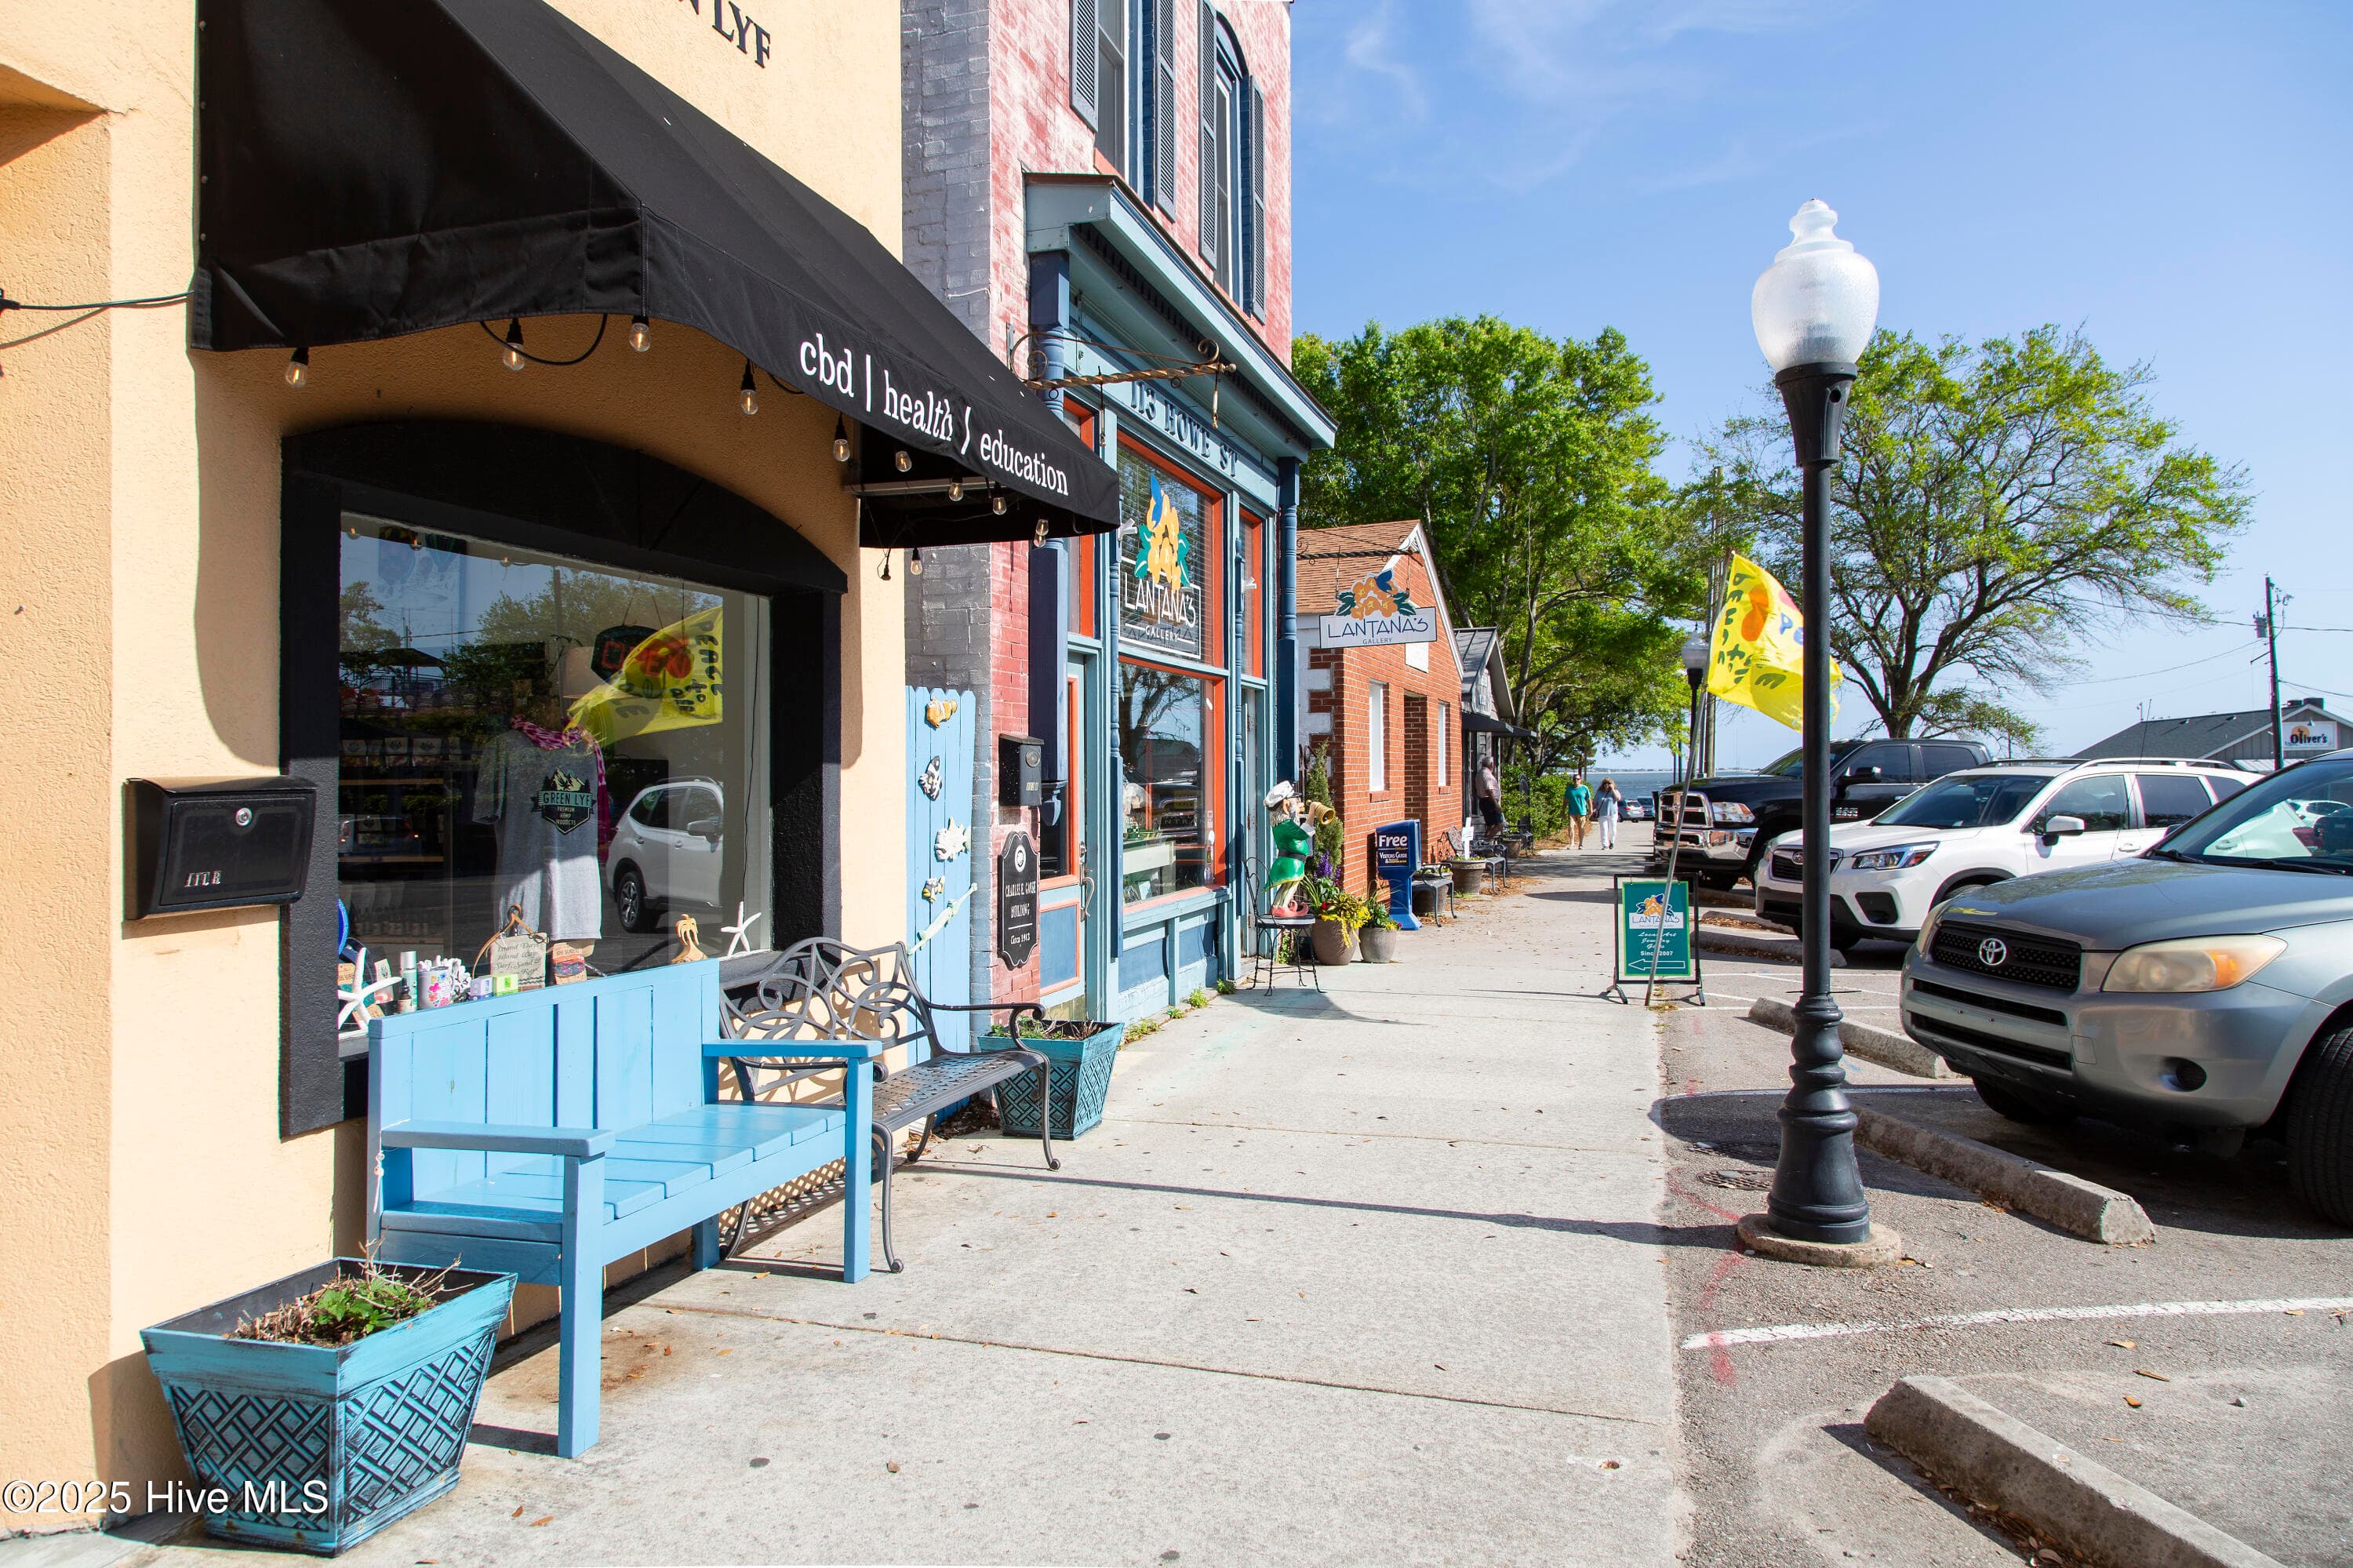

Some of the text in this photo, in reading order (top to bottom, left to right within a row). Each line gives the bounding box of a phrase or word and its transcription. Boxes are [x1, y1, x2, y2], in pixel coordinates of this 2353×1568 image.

[712, 0, 771, 69] LYF
[799, 333, 1069, 497] cbd health education
[1165, 399, 1211, 458] HOWE
[1220, 442, 1238, 477] ST
[1125, 572, 1197, 628] LANTANA'S
[1145, 625, 1179, 643] GALLERY
[1328, 615, 1429, 638] LANTANA'S
[2290, 729, 2328, 744] Oliver's
[543, 791, 571, 805] GREEN
[1379, 835, 1408, 847] Free
[1010, 904, 1030, 919] BUILDING
